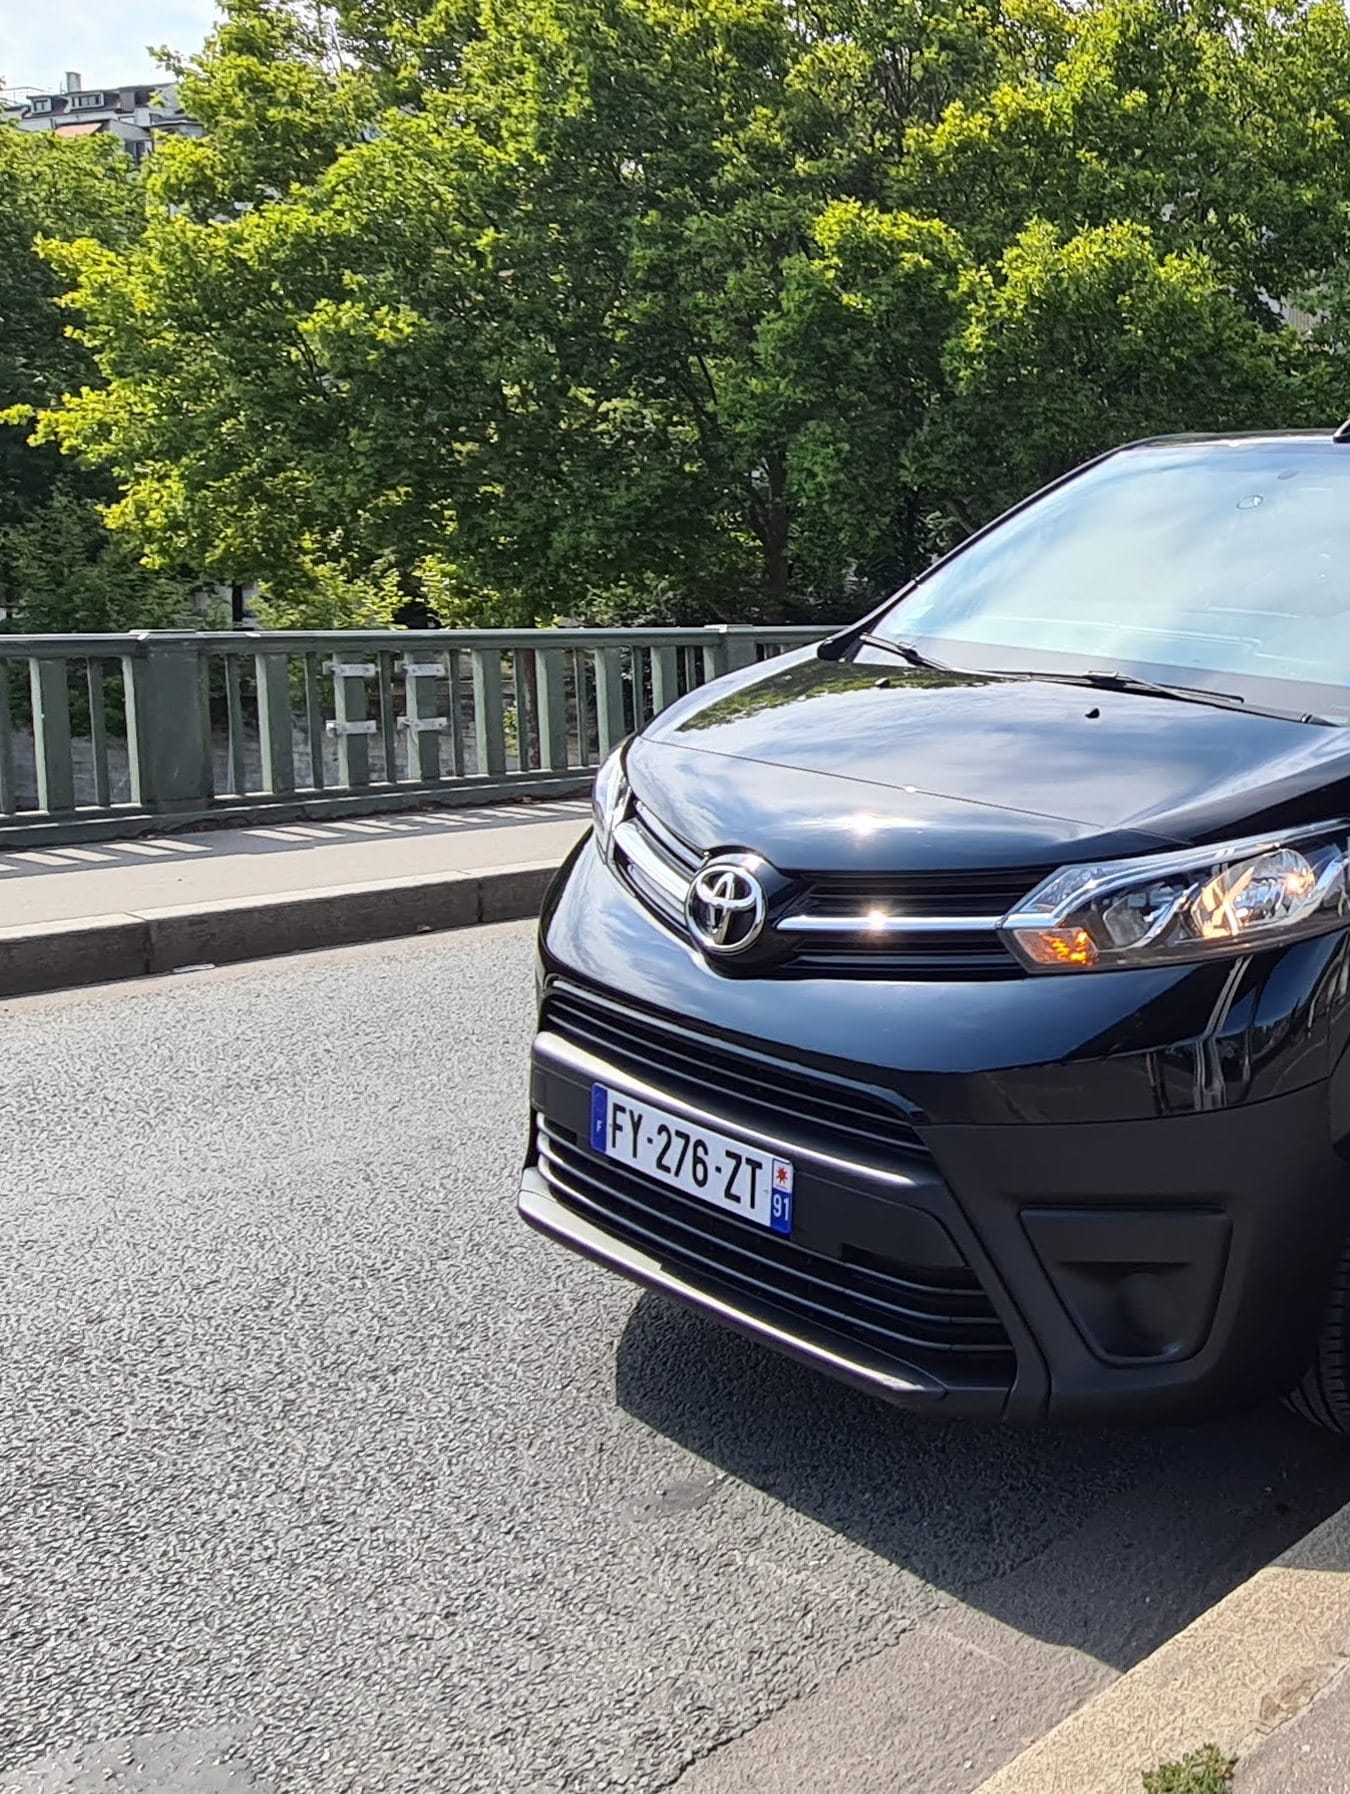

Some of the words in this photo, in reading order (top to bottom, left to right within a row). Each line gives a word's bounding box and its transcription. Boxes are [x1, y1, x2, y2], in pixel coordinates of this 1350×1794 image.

[596, 1120, 603, 1132] F
[611, 1102, 763, 1209] FY-276-ZT
[773, 1194, 789, 1221] 91
